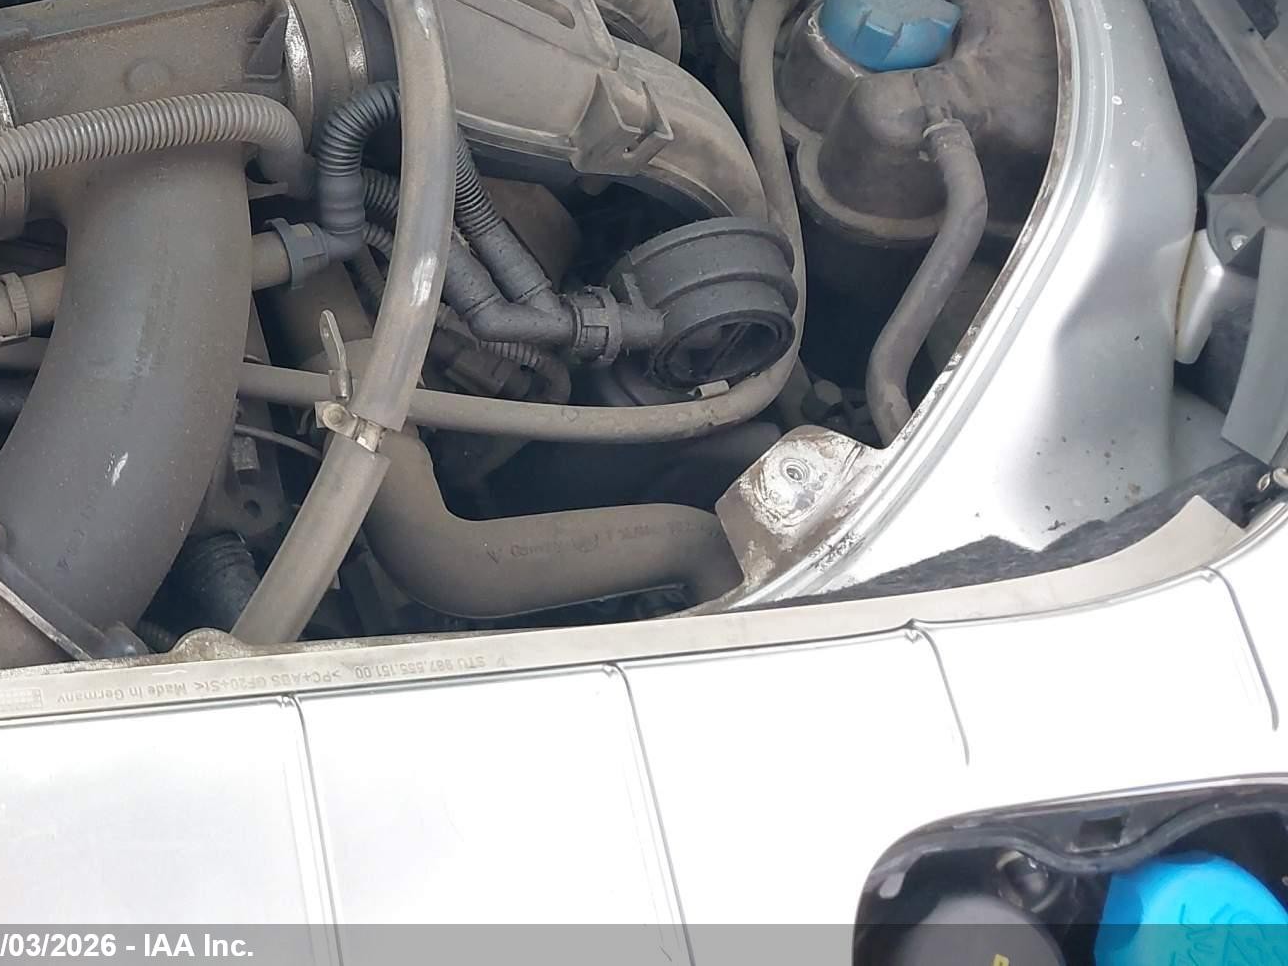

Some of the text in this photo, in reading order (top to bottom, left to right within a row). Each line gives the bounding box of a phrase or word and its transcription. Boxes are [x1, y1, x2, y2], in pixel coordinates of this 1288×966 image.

[456, 655, 486, 670] STU
[56, 688, 125, 704] Germany
[148, 682, 189, 697] Made
